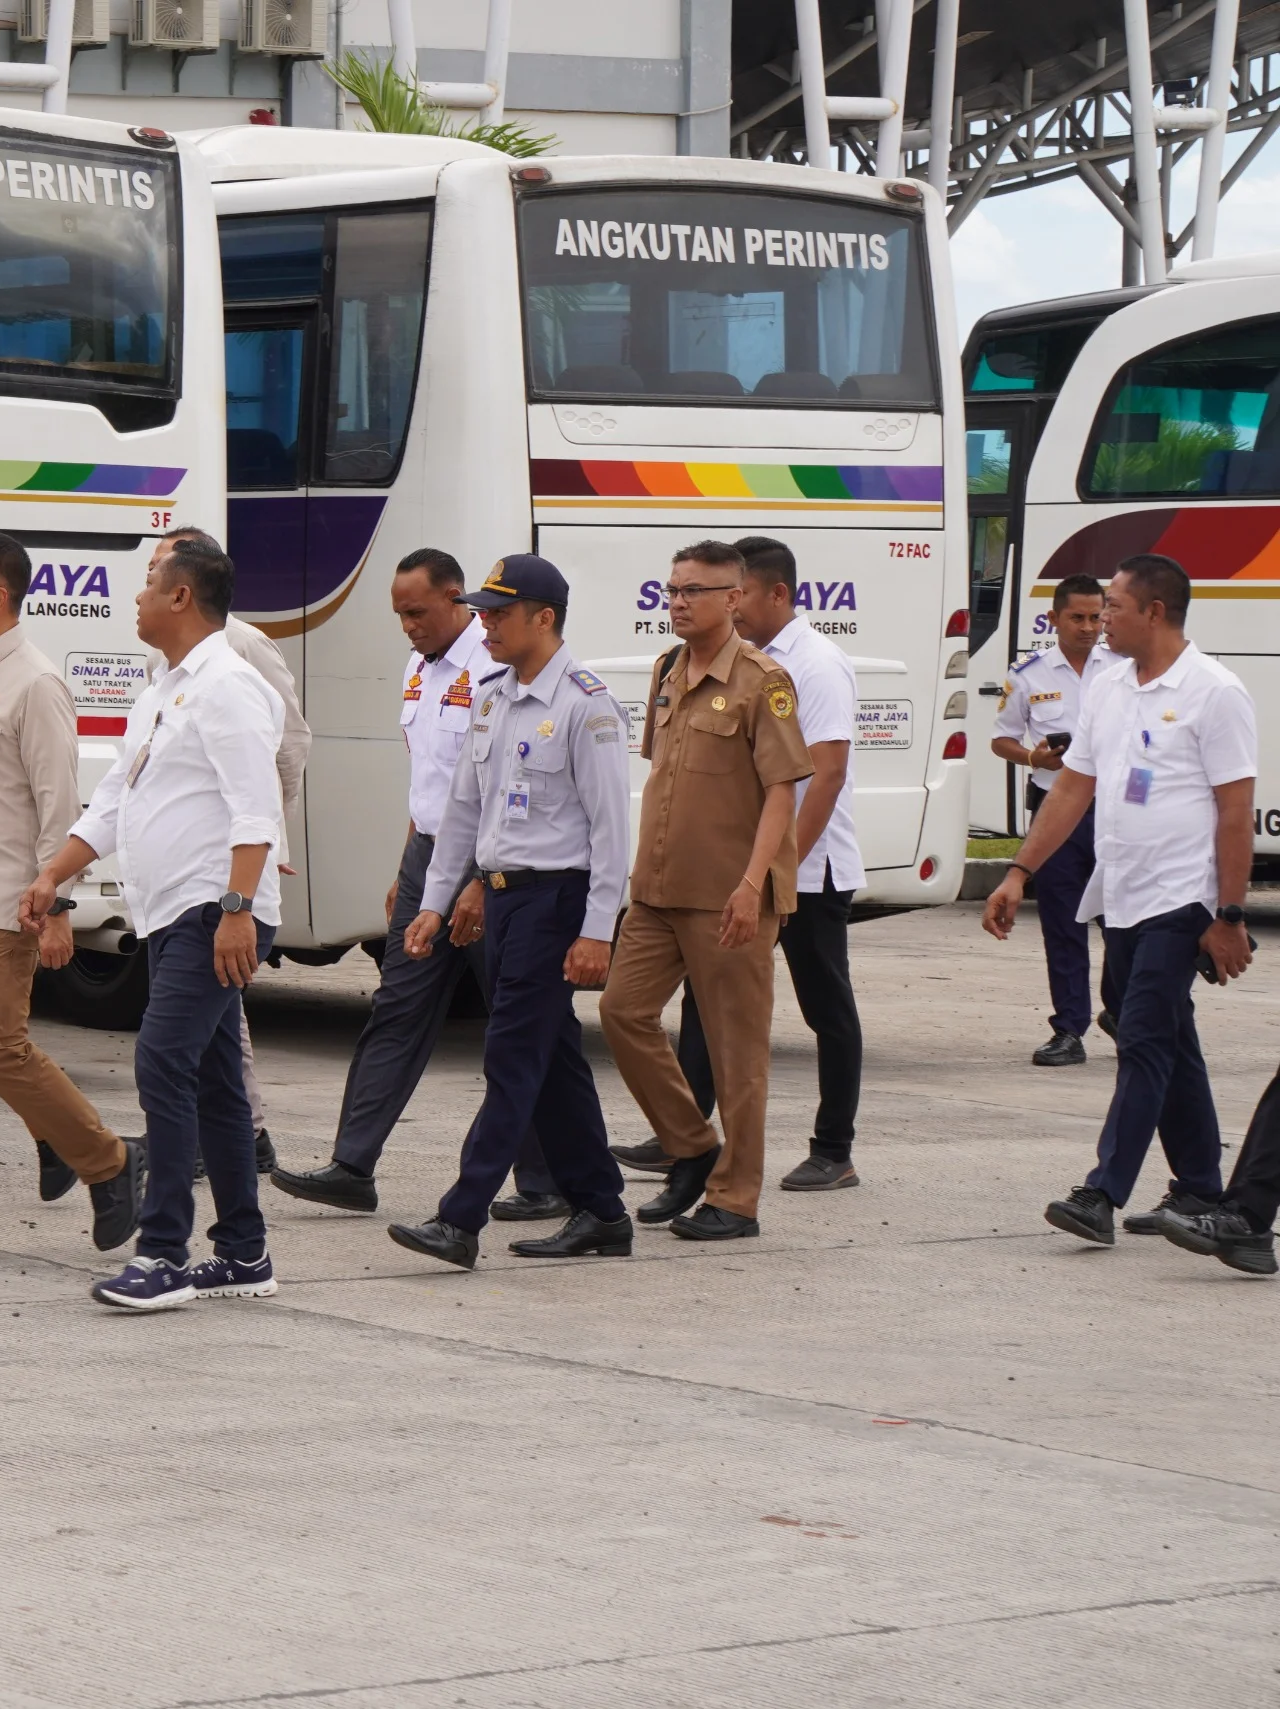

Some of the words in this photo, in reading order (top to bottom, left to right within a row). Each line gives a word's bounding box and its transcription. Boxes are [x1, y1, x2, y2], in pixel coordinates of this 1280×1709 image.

[555, 218, 736, 263] ANGKUTAN
[744, 228, 889, 270] PERINTIS
[889, 542, 904, 558] 72
[907, 543, 931, 559] FAC
[28, 564, 110, 598] AYA
[794, 581, 857, 611] AYA
[27, 601, 111, 618] LANGGENG
[635, 621, 653, 635] PT.
[811, 622, 857, 635] GGENG
[71, 665, 110, 677] SINAR
[114, 667, 144, 678] JAYA
[854, 712, 880, 721] INAR
[884, 712, 908, 721] JAYA
